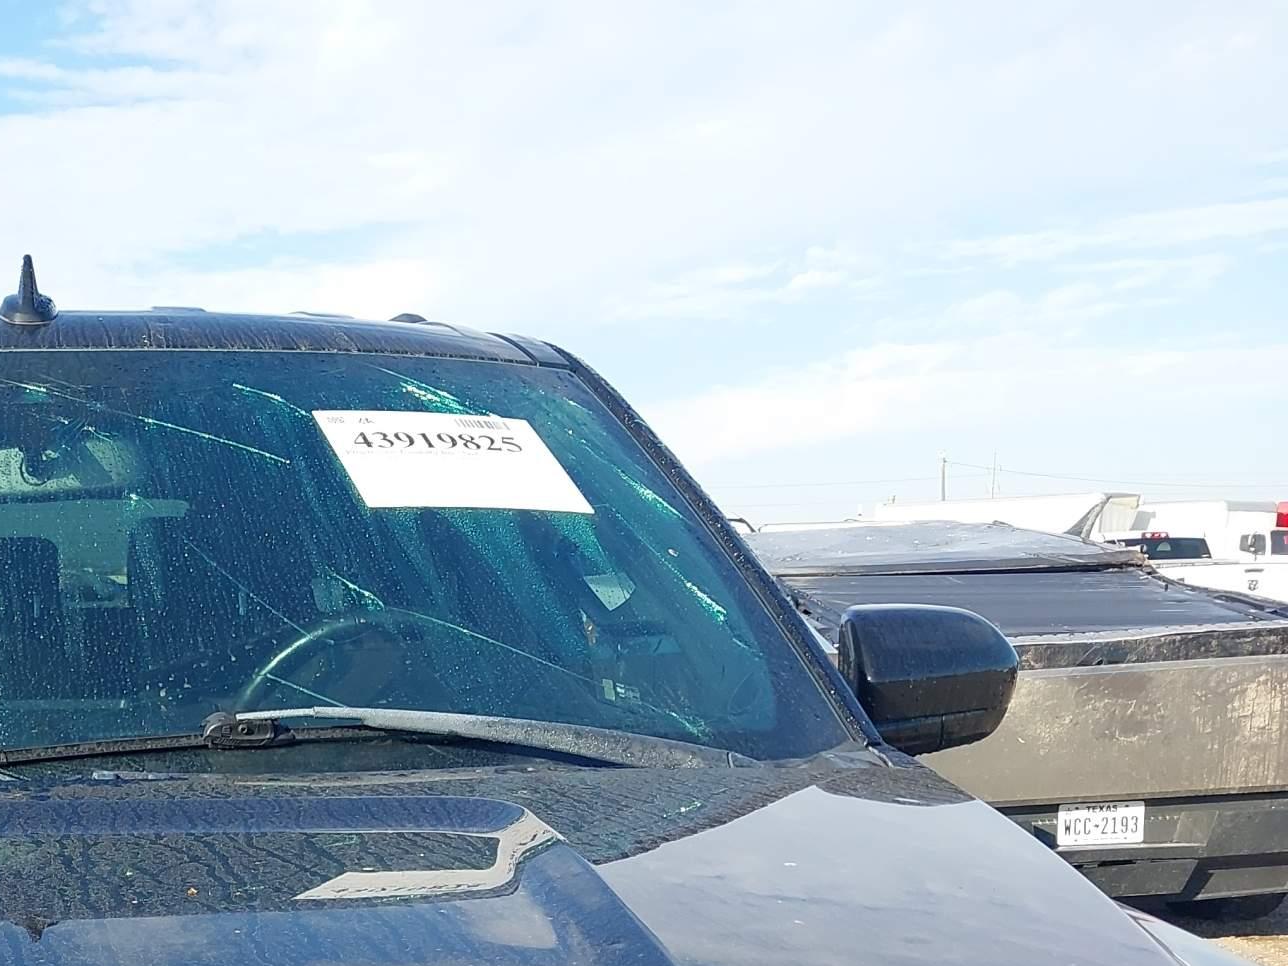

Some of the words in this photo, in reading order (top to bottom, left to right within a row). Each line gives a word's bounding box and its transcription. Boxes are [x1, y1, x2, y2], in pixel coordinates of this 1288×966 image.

[353, 431, 523, 453] 43919825
[1086, 804, 1118, 813] TEXAS
[1064, 816, 1139, 836] WCC-2193
